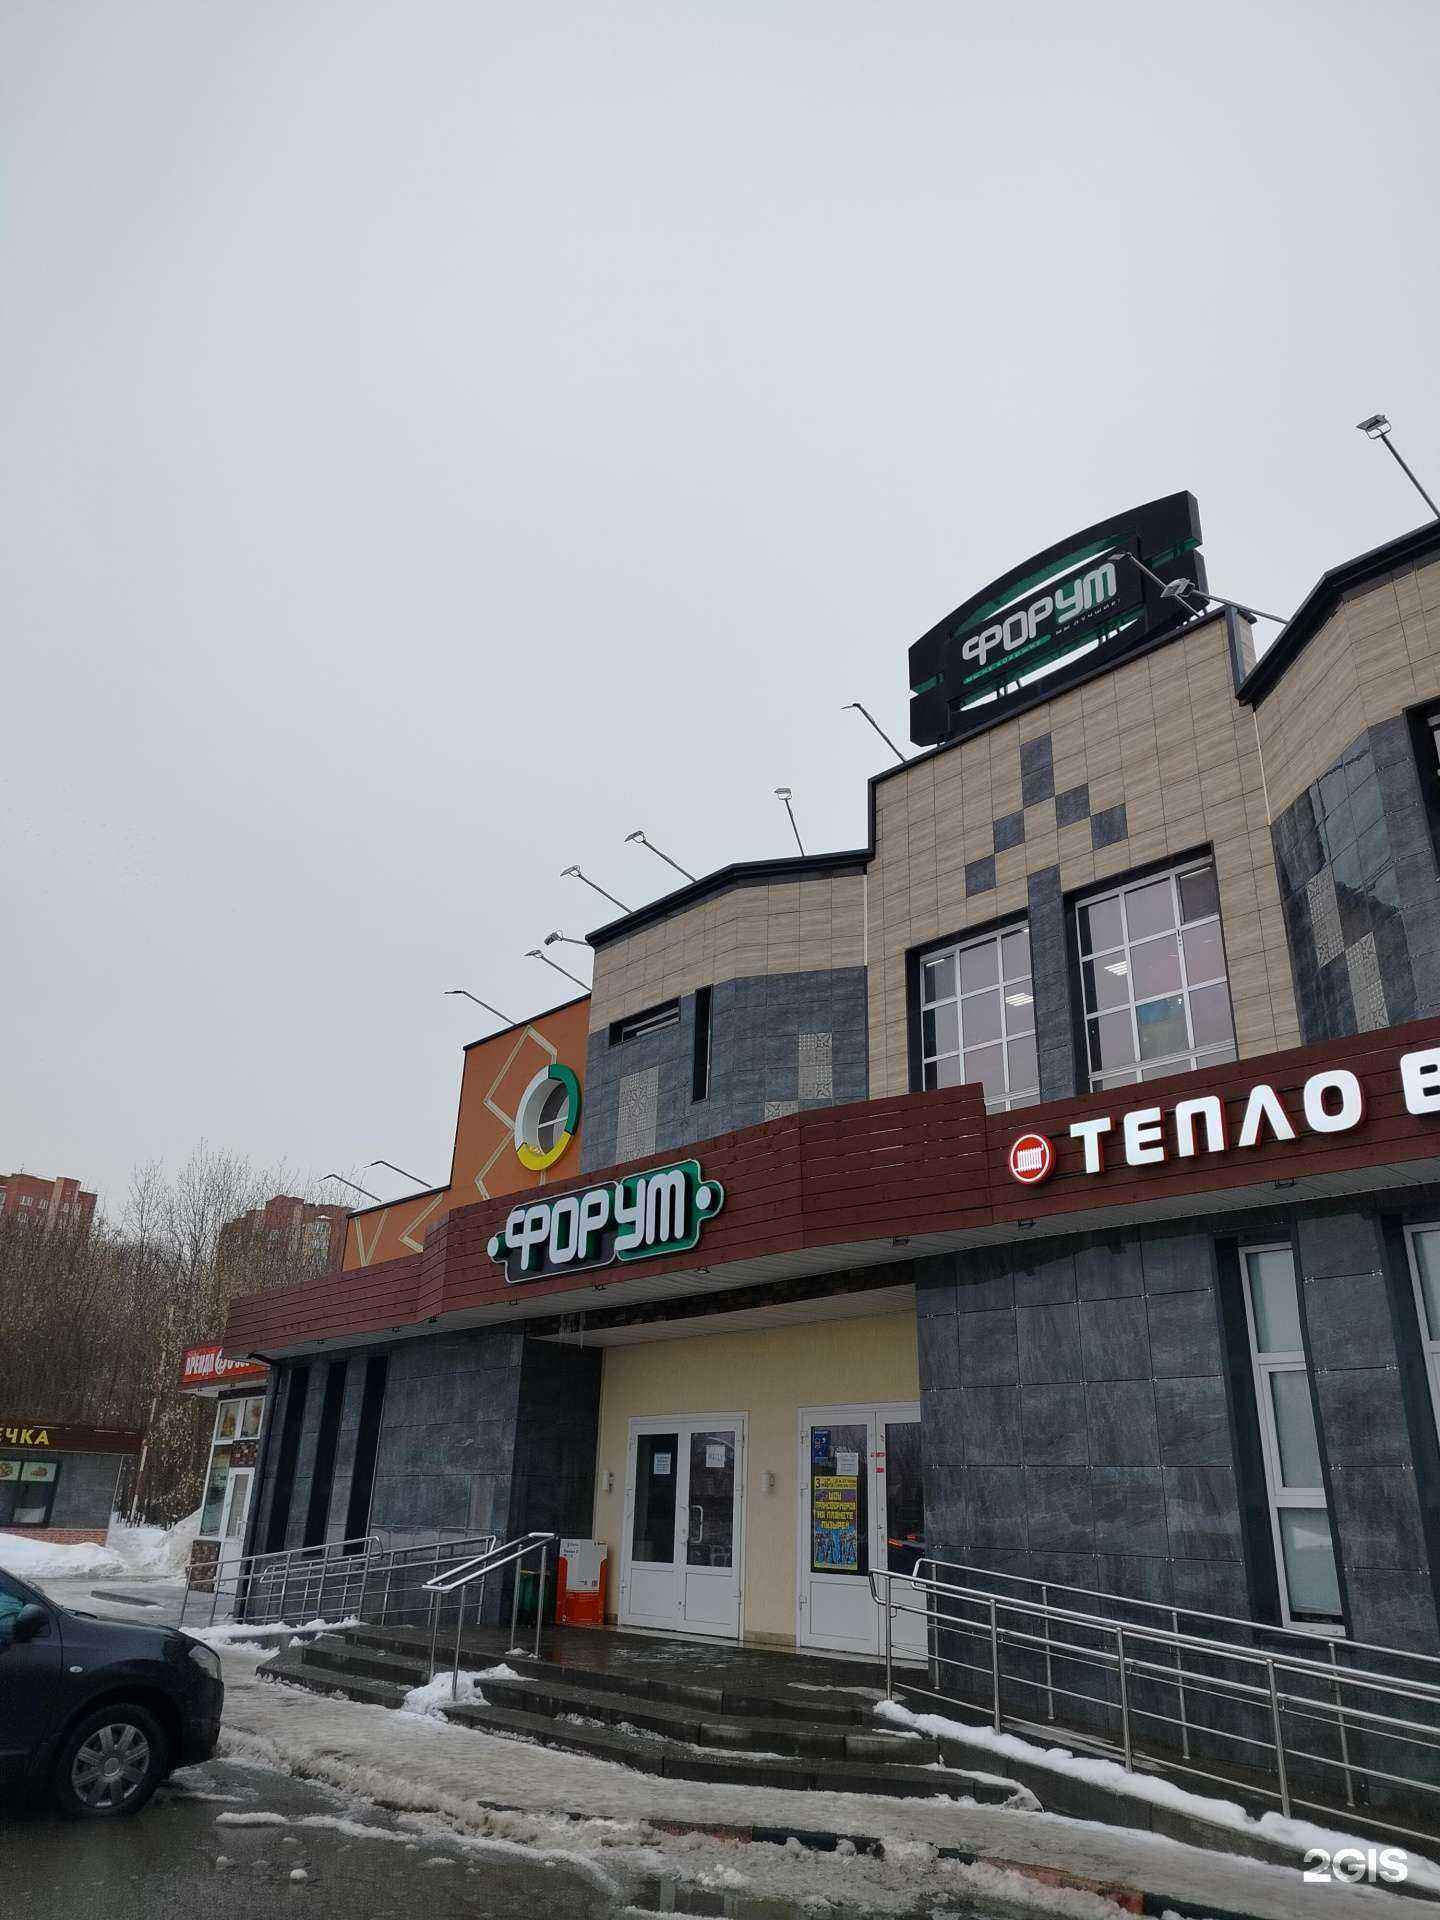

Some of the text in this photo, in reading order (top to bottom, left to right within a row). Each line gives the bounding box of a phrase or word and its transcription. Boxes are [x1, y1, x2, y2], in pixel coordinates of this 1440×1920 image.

[961, 562, 1118, 666] ФОРУМ
[1069, 1069, 1363, 1175] ТЕПЛО
[504, 1169, 687, 1272] ФОРУМ
